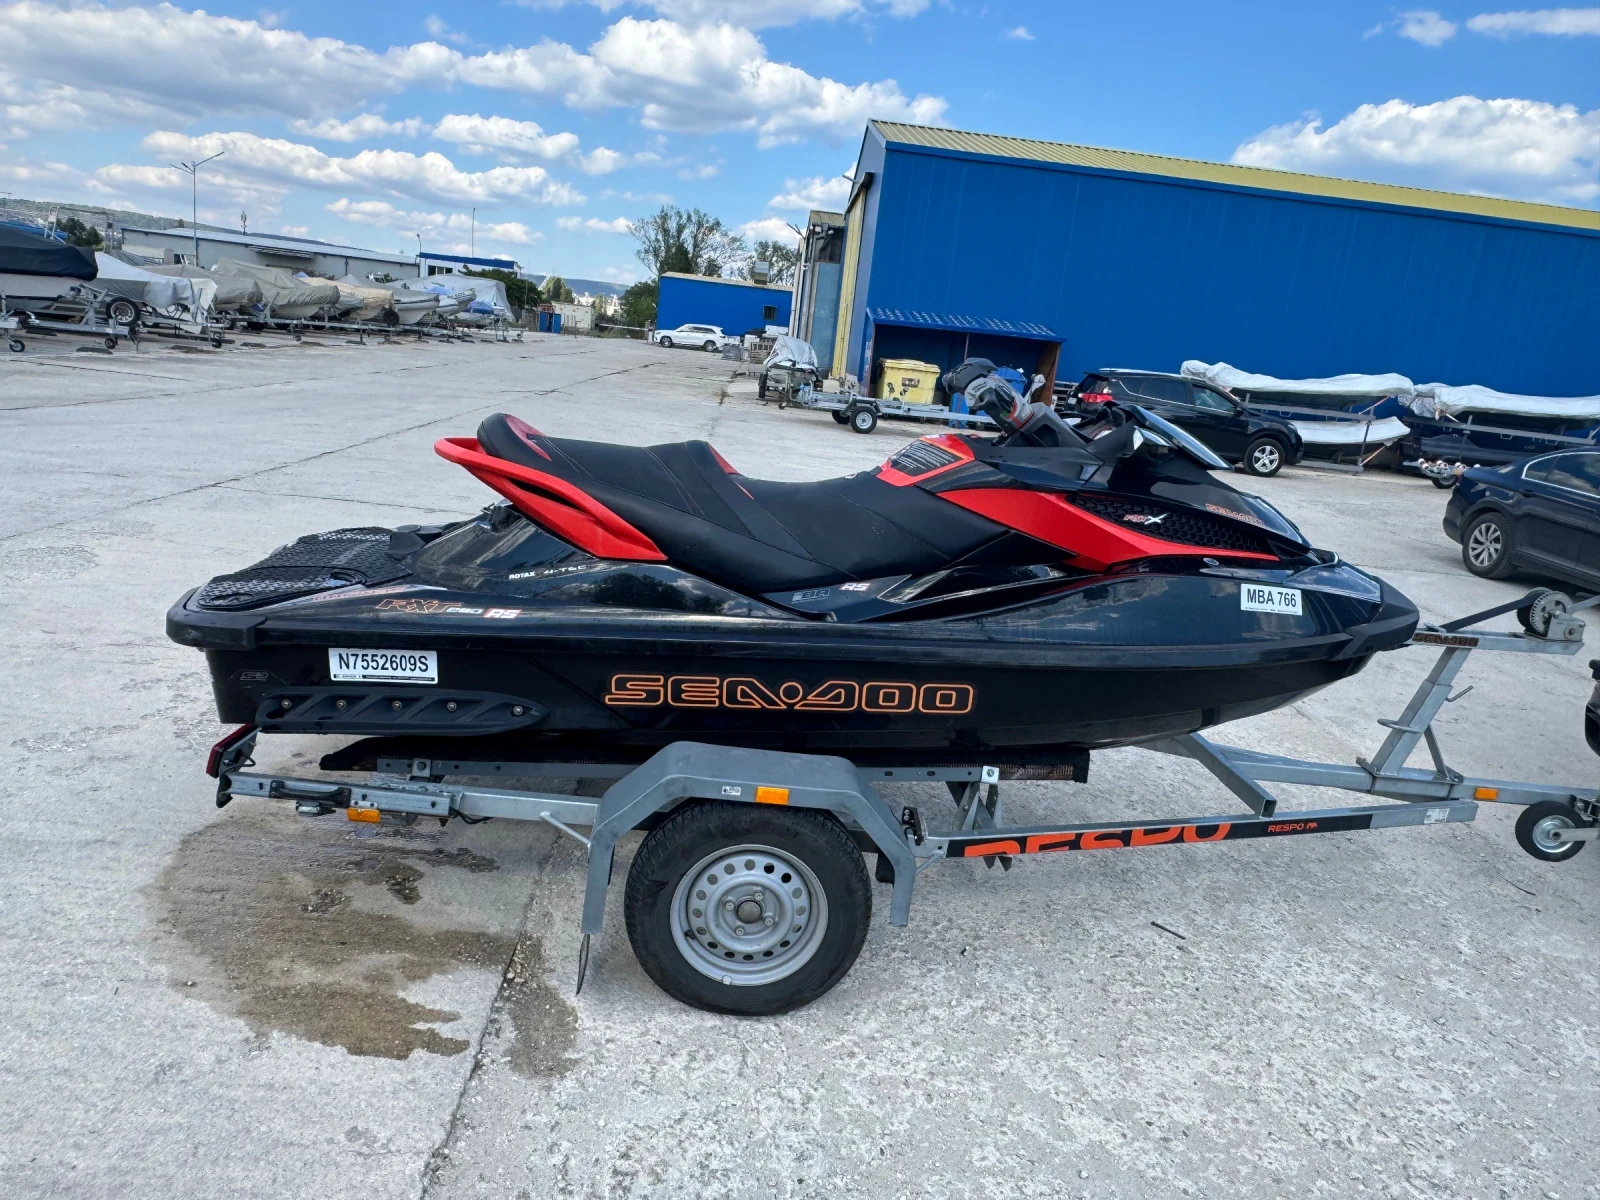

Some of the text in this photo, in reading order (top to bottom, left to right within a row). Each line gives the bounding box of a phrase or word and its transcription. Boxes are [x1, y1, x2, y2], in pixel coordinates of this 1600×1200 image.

[508, 571, 536, 580] ROTAX
[1247, 588, 1297, 607] MBA 766
[338, 652, 429, 672] N7552609S
[1267, 823, 1304, 833] RESPO
